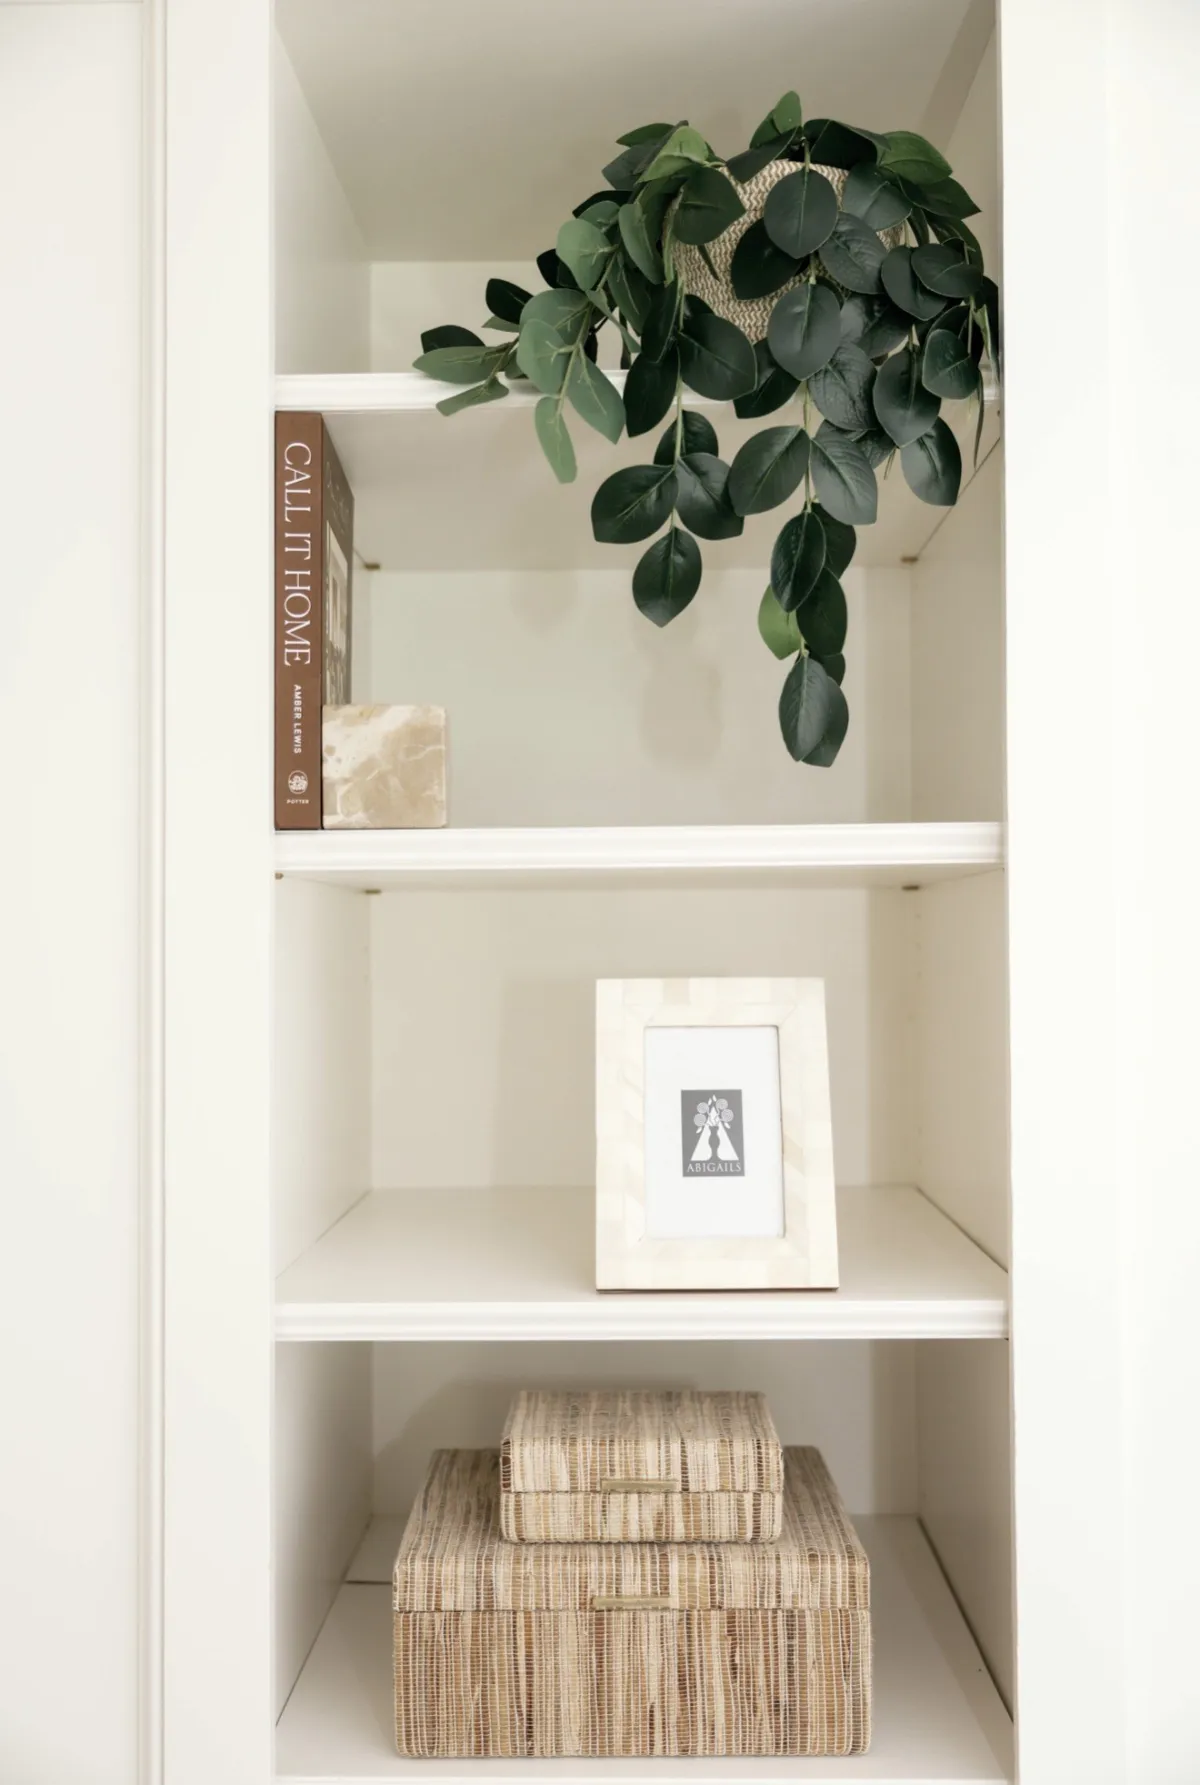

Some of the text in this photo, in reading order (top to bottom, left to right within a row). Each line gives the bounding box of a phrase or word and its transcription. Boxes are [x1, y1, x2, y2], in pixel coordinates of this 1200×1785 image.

[284, 442, 311, 666] CALL IT HOME
[293, 684, 302, 753] AMBER LEWIS
[686, 1162, 742, 1173] ABIGAILS
